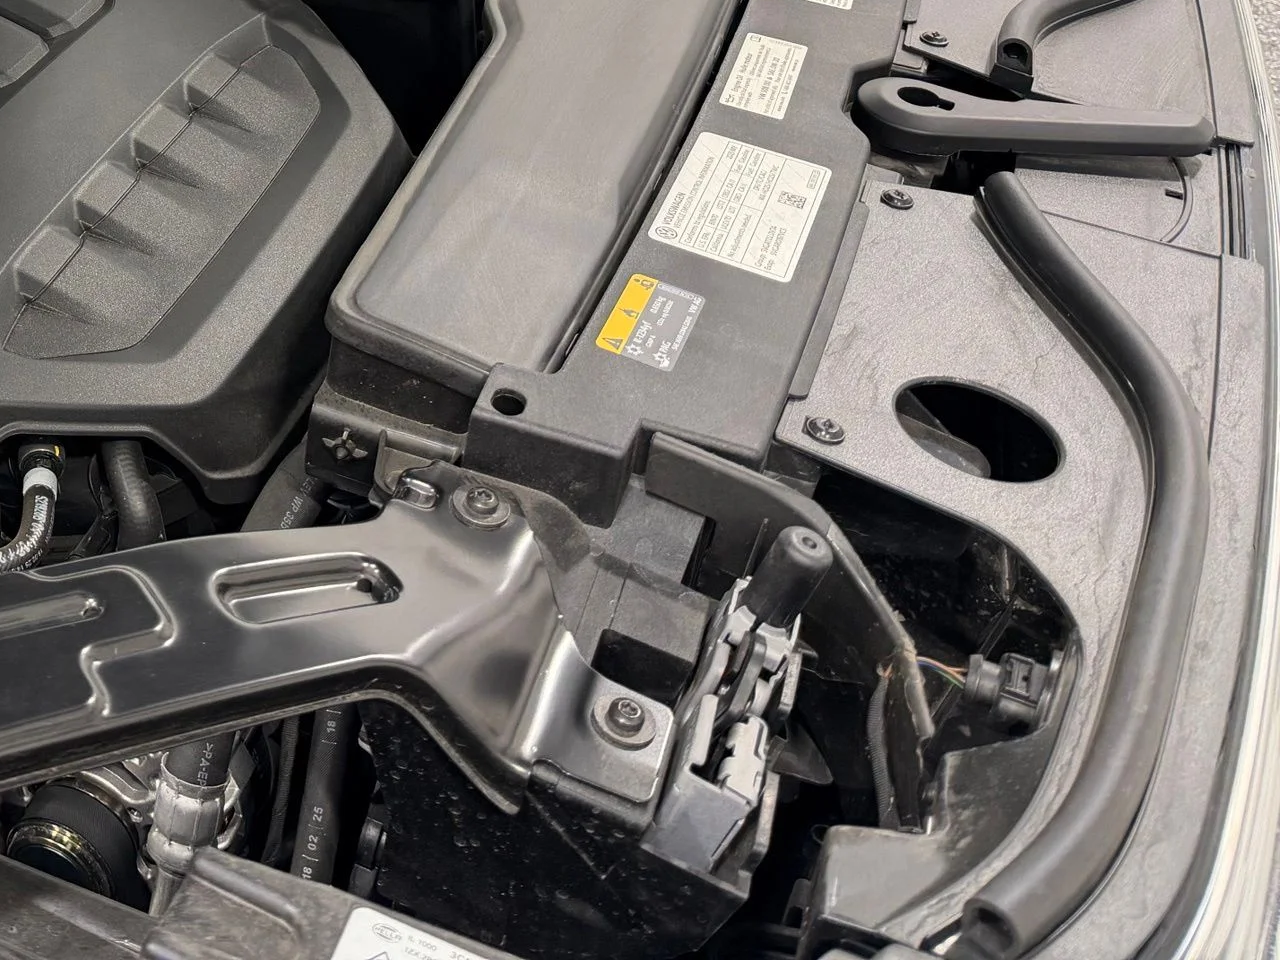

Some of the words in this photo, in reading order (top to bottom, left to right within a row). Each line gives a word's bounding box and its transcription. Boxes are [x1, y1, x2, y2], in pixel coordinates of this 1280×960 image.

[663, 191, 685, 225] VOLKSWAGEN
[659, 340, 670, 352] PAG
[325, 719, 337, 733] 18
[311, 805, 324, 822] 25
[305, 833, 319, 851] 02
